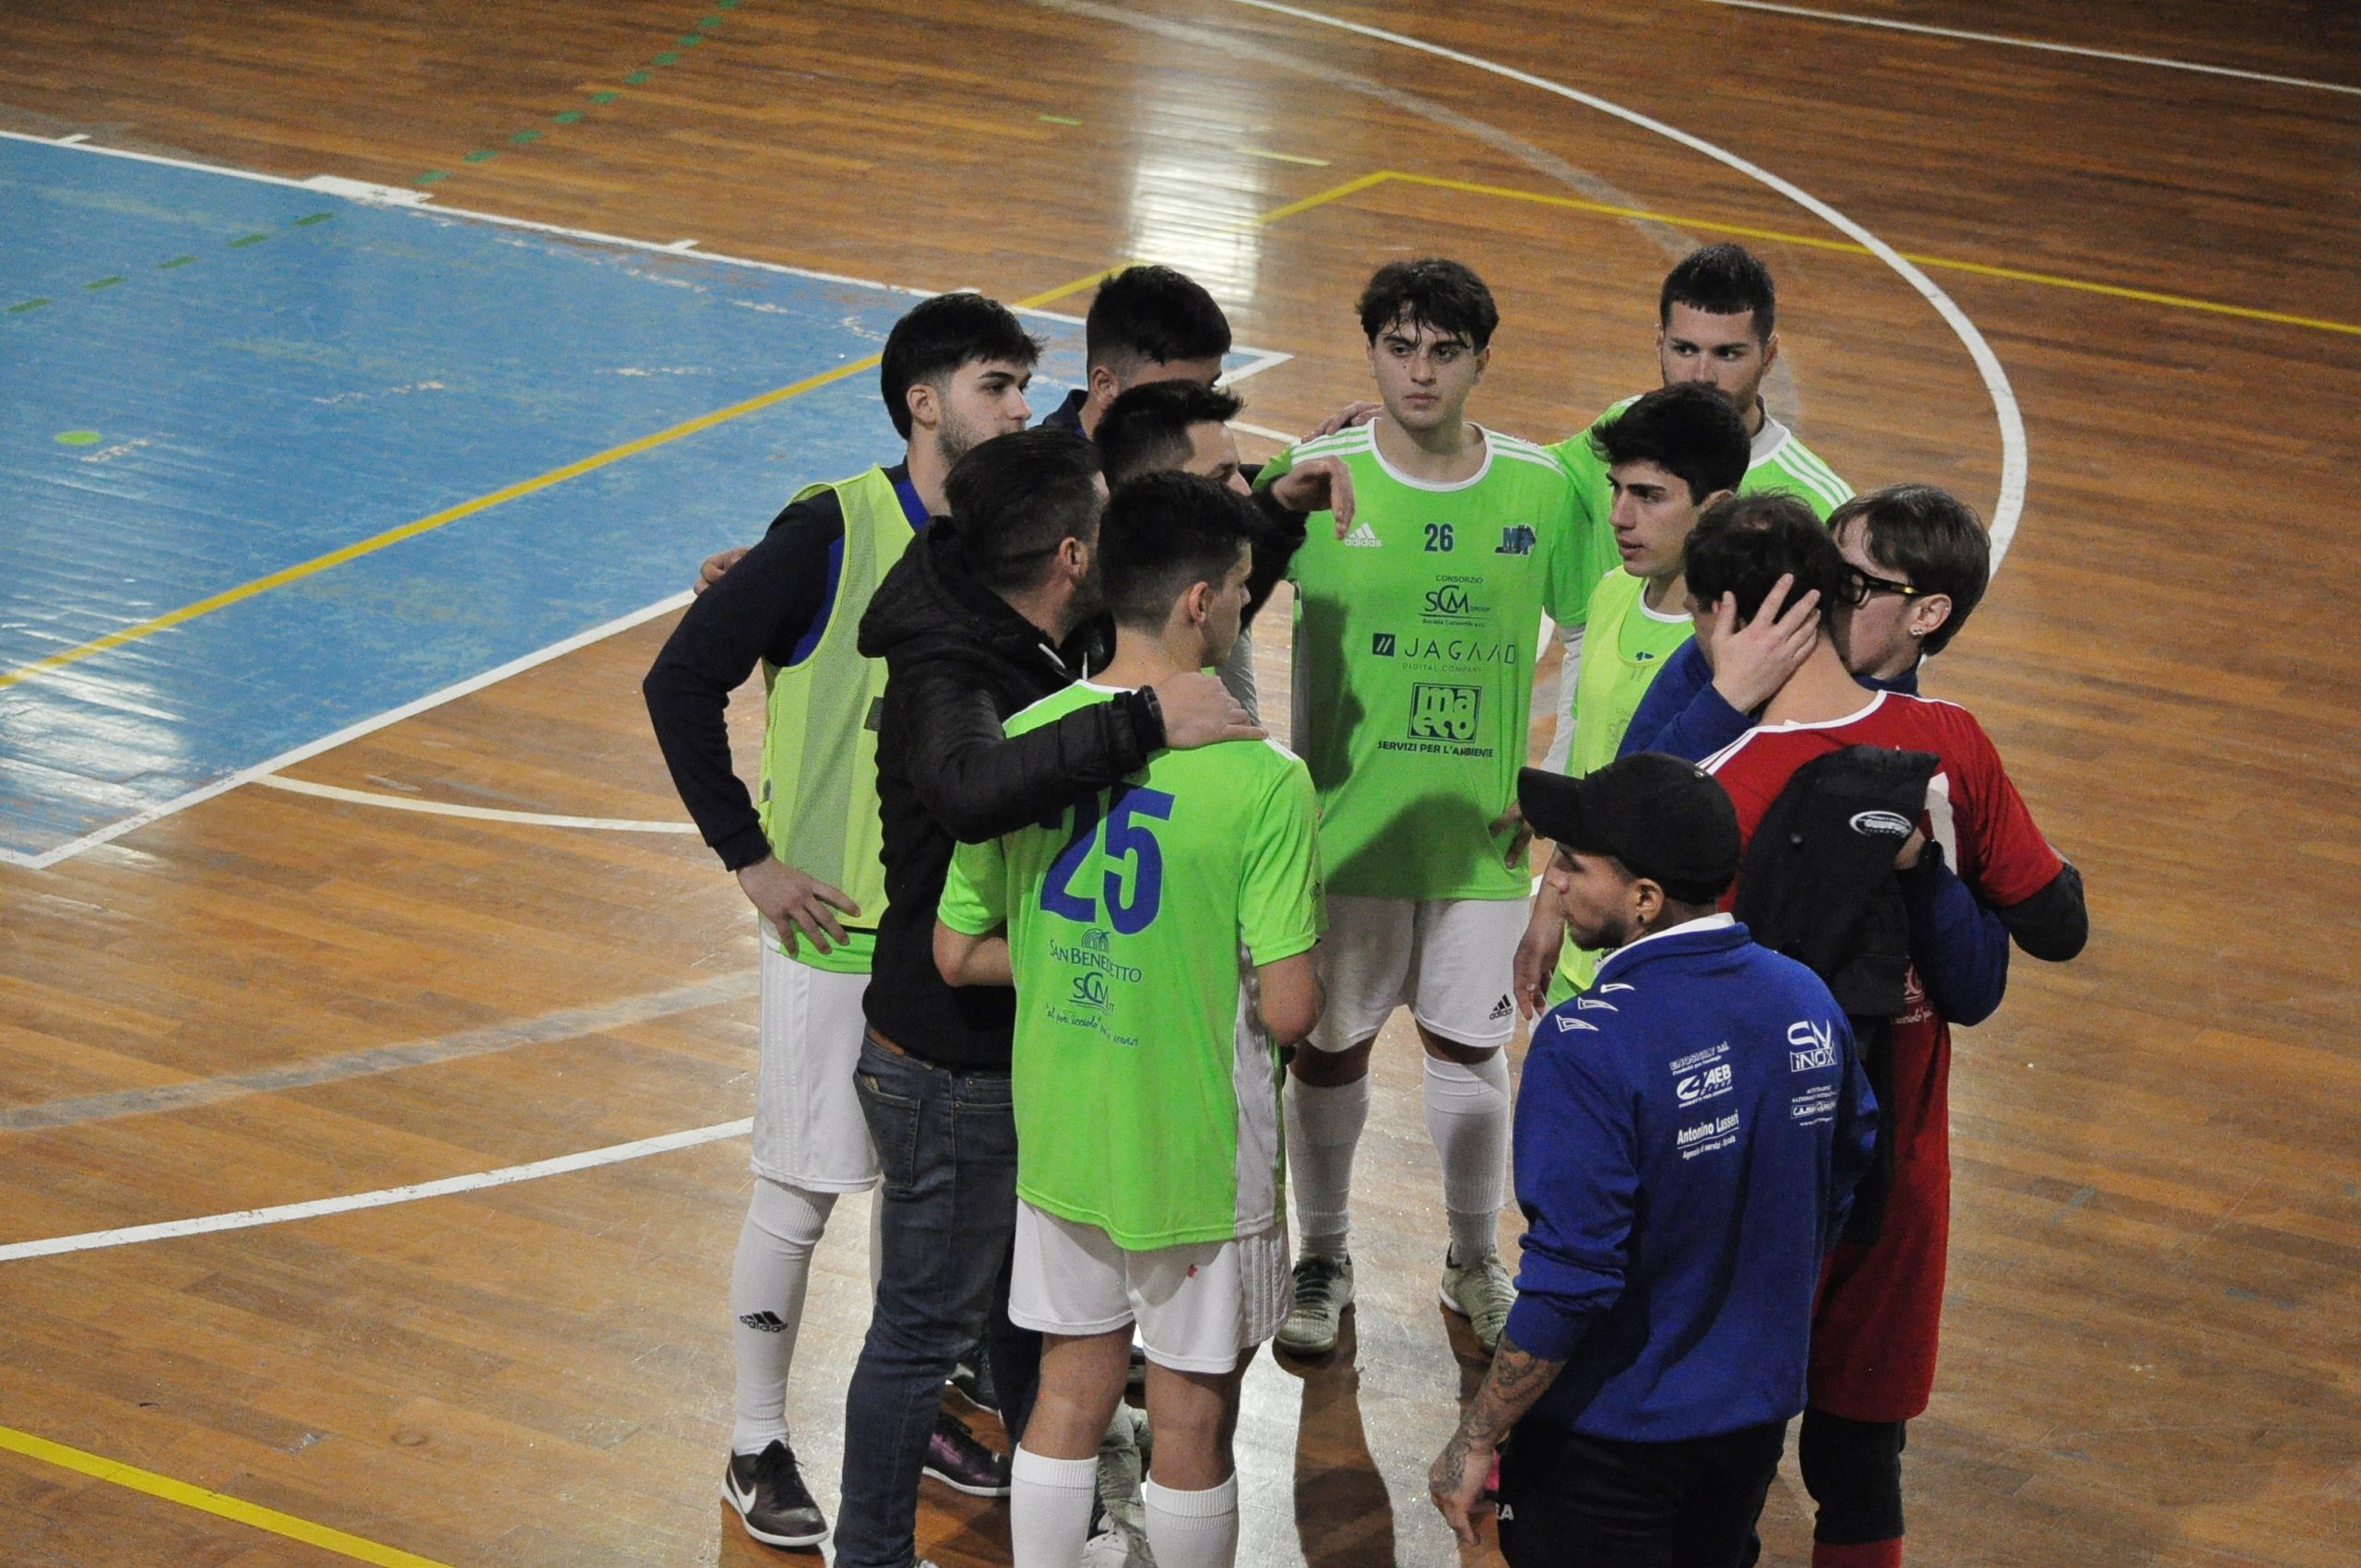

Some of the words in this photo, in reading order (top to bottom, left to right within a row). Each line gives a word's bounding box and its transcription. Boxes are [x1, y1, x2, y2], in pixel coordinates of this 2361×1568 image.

[1344, 538, 1382, 547] adidas
[1424, 523, 1454, 552] 26
[1435, 575, 1483, 585] CONSORZIO
[1424, 584, 1469, 614] SCM
[1402, 662, 1440, 672] DIGITAL
[1378, 741, 1418, 751] SERVIZI
[1419, 743, 1442, 754] PER
[1039, 786, 1176, 935] 25
[1050, 939, 1069, 963] SAN
[1073, 971, 1109, 1008] SCM
[1489, 1006, 1513, 1020] adidas
[1704, 1063, 1732, 1088] AEB
[1677, 1122, 1714, 1146] Antonino
[739, 1315, 789, 1333] adidas
